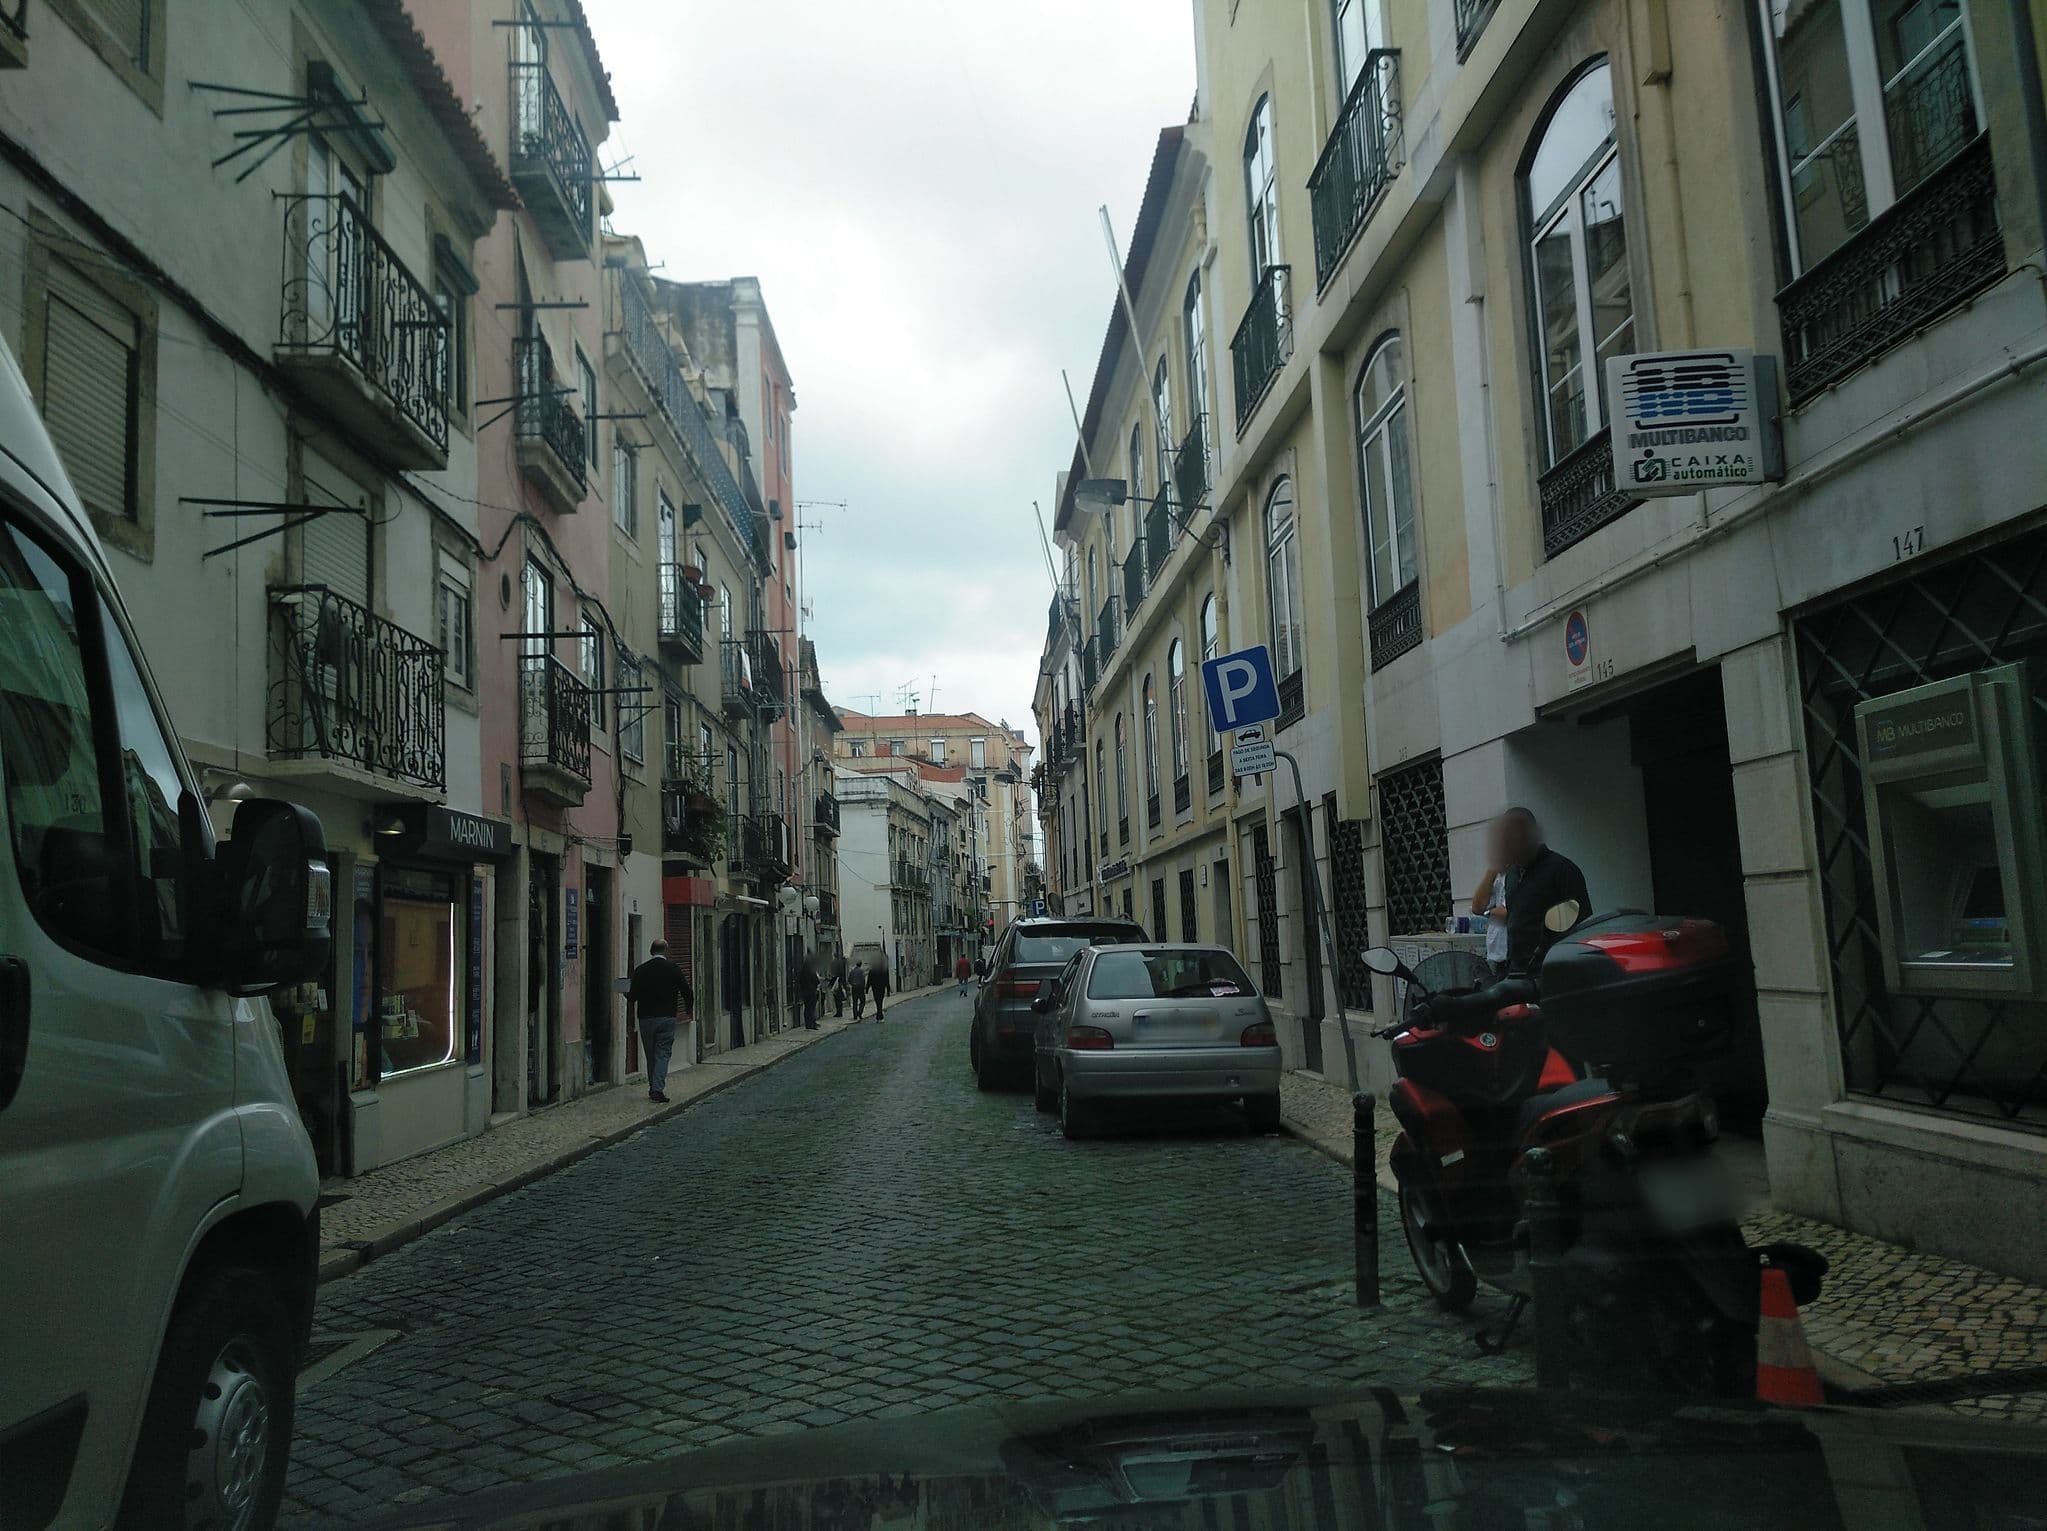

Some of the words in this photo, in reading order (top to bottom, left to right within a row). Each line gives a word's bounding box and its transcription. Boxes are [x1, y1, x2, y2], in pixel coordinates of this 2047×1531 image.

[1628, 427, 1749, 448] MULTIBANCO
[1672, 455, 1746, 468] CAIXA
[1673, 464, 1747, 480] automático
[1893, 526, 1924, 560] 147
[1597, 659, 1614, 681] 145
[1216, 659, 1258, 723] P
[1898, 712, 1965, 738] MULTIBANCO
[450, 815, 494, 849] MARNIN
[1035, 900, 1045, 915] P
